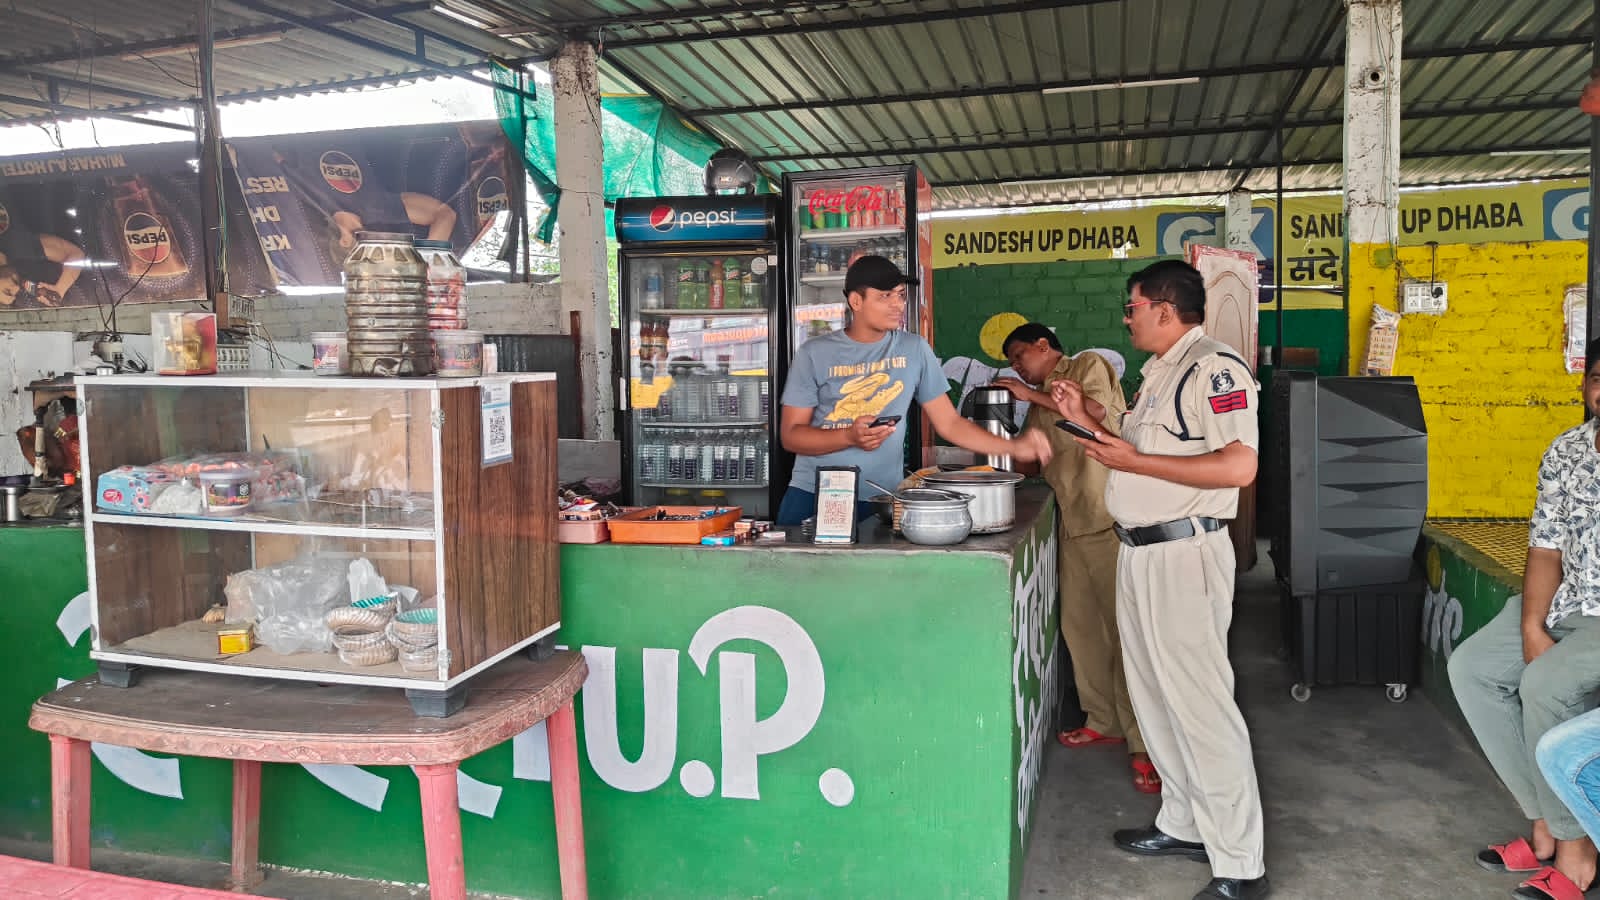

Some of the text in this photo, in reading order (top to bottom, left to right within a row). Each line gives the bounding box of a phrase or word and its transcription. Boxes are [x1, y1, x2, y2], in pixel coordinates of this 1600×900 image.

[47, 152, 127, 174] MAHARAJ
[322, 165, 360, 180] PEPSI
[679, 207, 737, 228] pepsi
[1401, 207, 1432, 234] UP
[1437, 201, 1524, 233] DHABA
[127, 230, 167, 246] PEPSI
[944, 229, 1034, 255] SANDESH
[1038, 228, 1064, 252] UP
[1067, 224, 1140, 250] DHABA
[581, 604, 855, 808] U.P.
